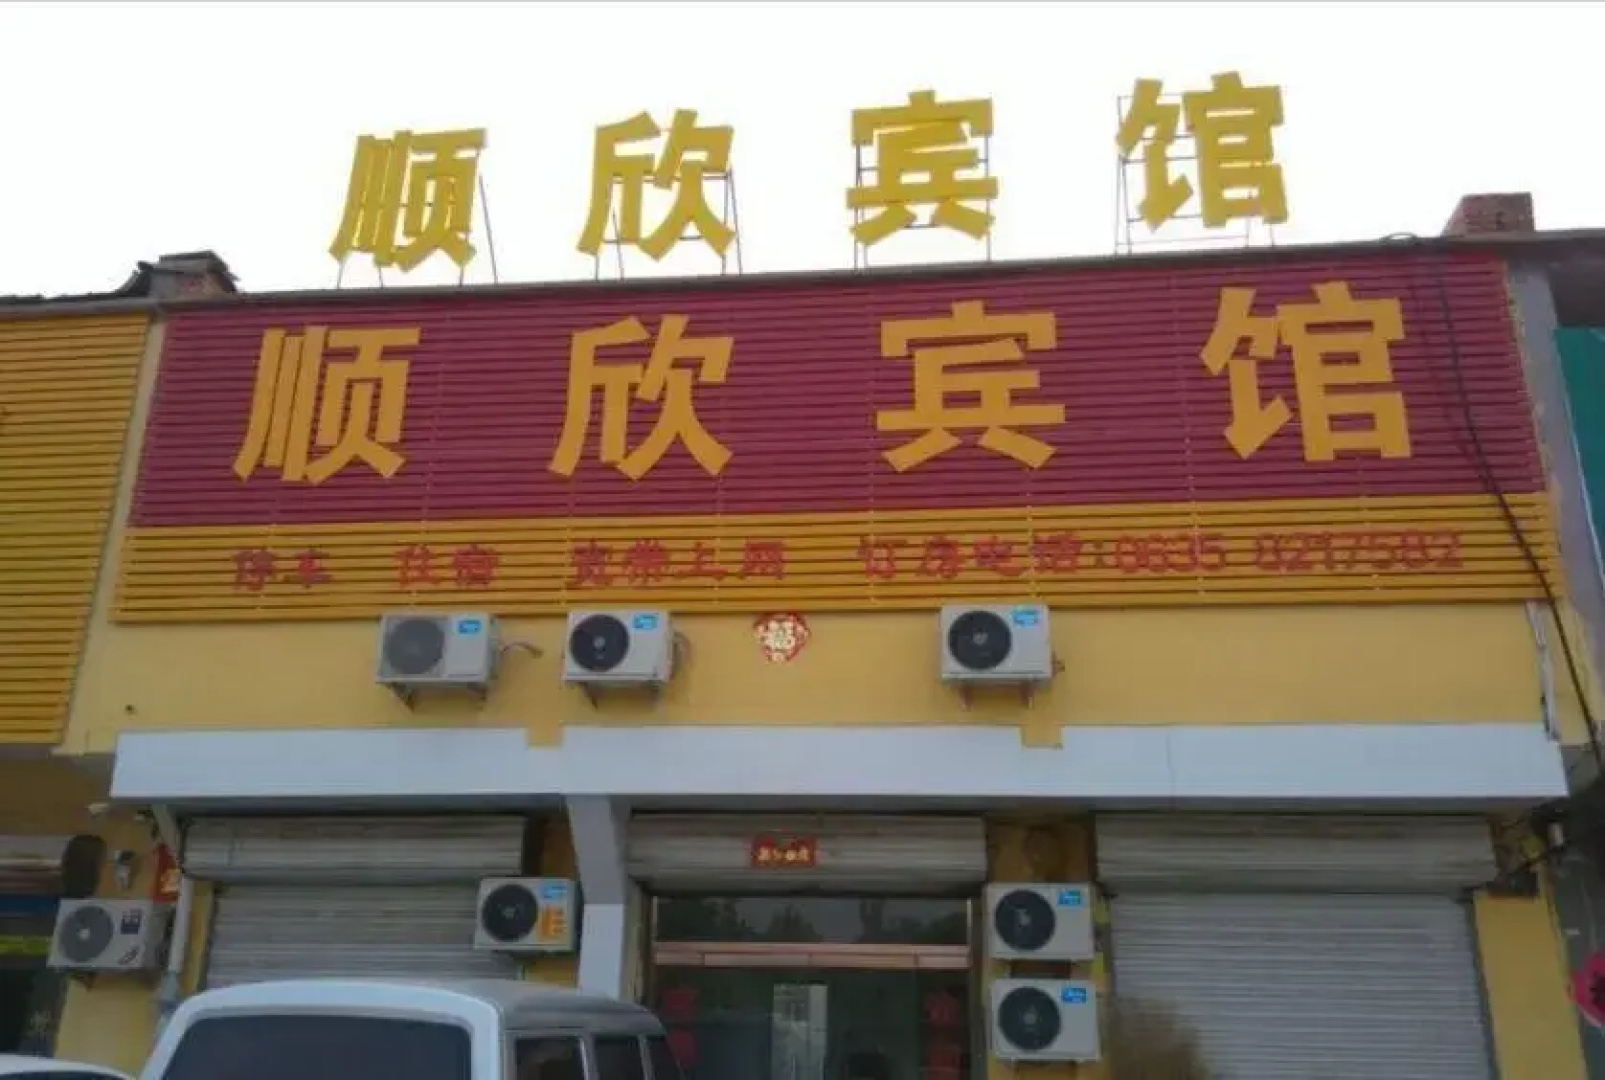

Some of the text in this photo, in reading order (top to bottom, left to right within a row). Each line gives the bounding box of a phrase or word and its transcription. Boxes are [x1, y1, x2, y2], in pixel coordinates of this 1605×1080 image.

[329, 70, 1289, 272] 顺欣宾馆
[233, 281, 1413, 483] 顺欣宾馆
[395, 543, 500, 588] 住宿
